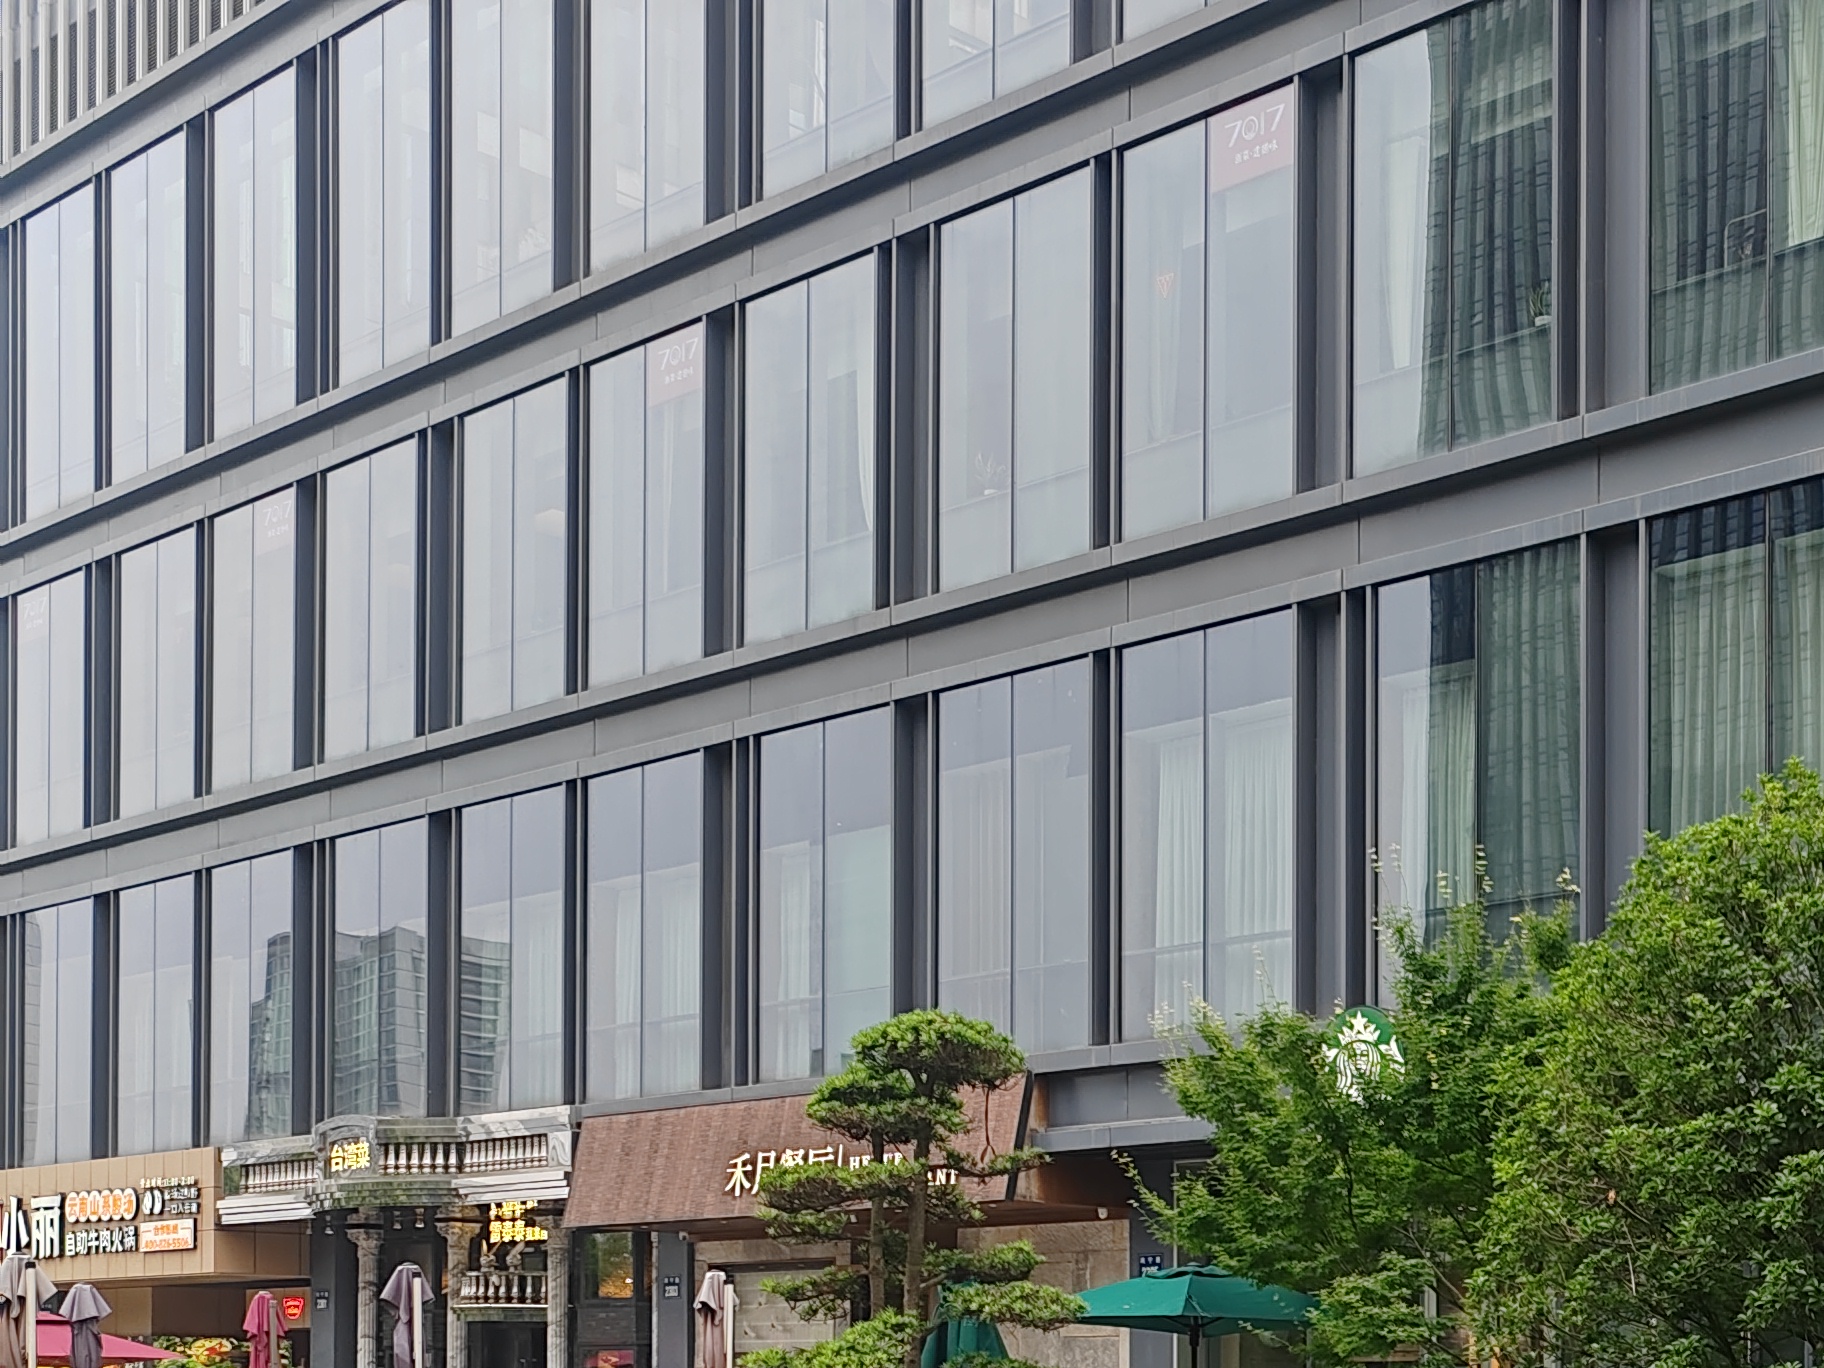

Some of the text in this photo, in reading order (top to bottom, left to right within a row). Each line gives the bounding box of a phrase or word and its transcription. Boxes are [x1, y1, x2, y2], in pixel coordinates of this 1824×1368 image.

[1224, 103, 1286, 148] 7017
[657, 336, 699, 371] 7017
[330, 1136, 371, 1172] 台湾菜
[1, 1194, 61, 1259] 小丽
[65, 1226, 137, 1257] 自助牛肉火锅
